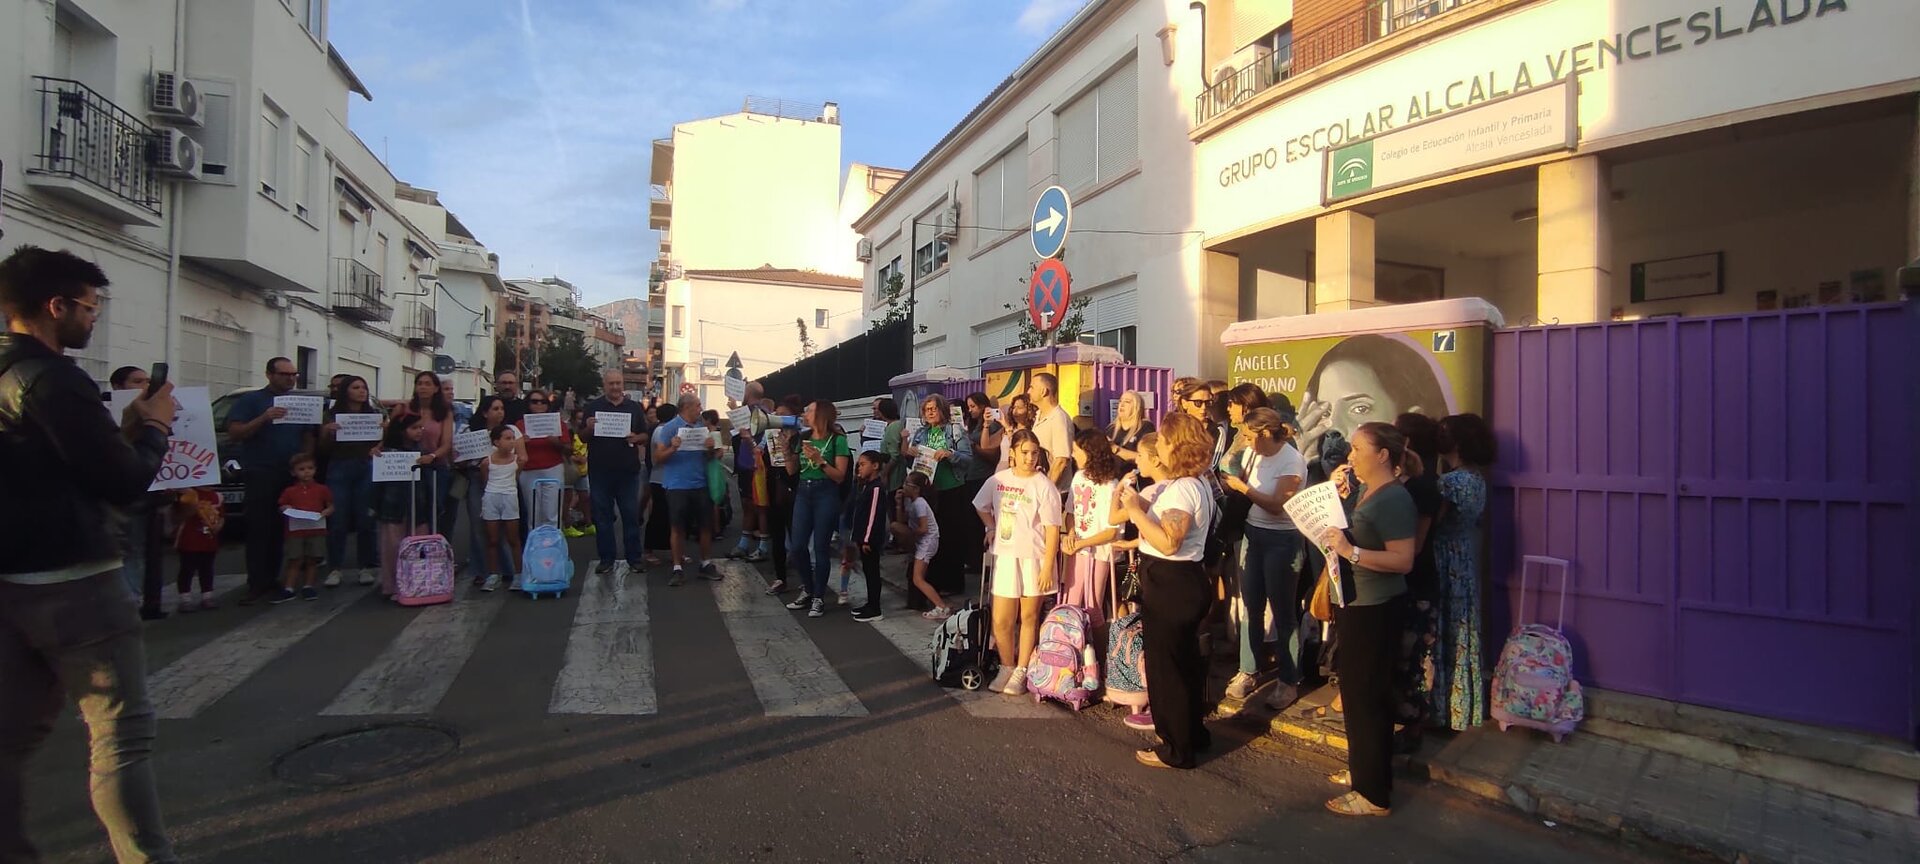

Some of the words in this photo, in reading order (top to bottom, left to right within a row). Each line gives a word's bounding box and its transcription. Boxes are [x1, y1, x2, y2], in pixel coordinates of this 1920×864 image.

[1219, 147, 1277, 188] GRUPO
[1286, 104, 1394, 164] ESCOLAR
[1407, 61, 1534, 123] ALCALA
[1381, 147, 1409, 162] Colegio
[1411, 142, 1421, 154] de
[1423, 131, 1466, 151] Educación
[1468, 121, 1500, 139] Infantil
[1502, 121, 1508, 131] y
[1511, 108, 1552, 127] Primaria
[1496, 124, 1553, 146] Venceslada
[1437, 330, 1451, 351] 7
[1233, 349, 1290, 373] ÁNGELES
